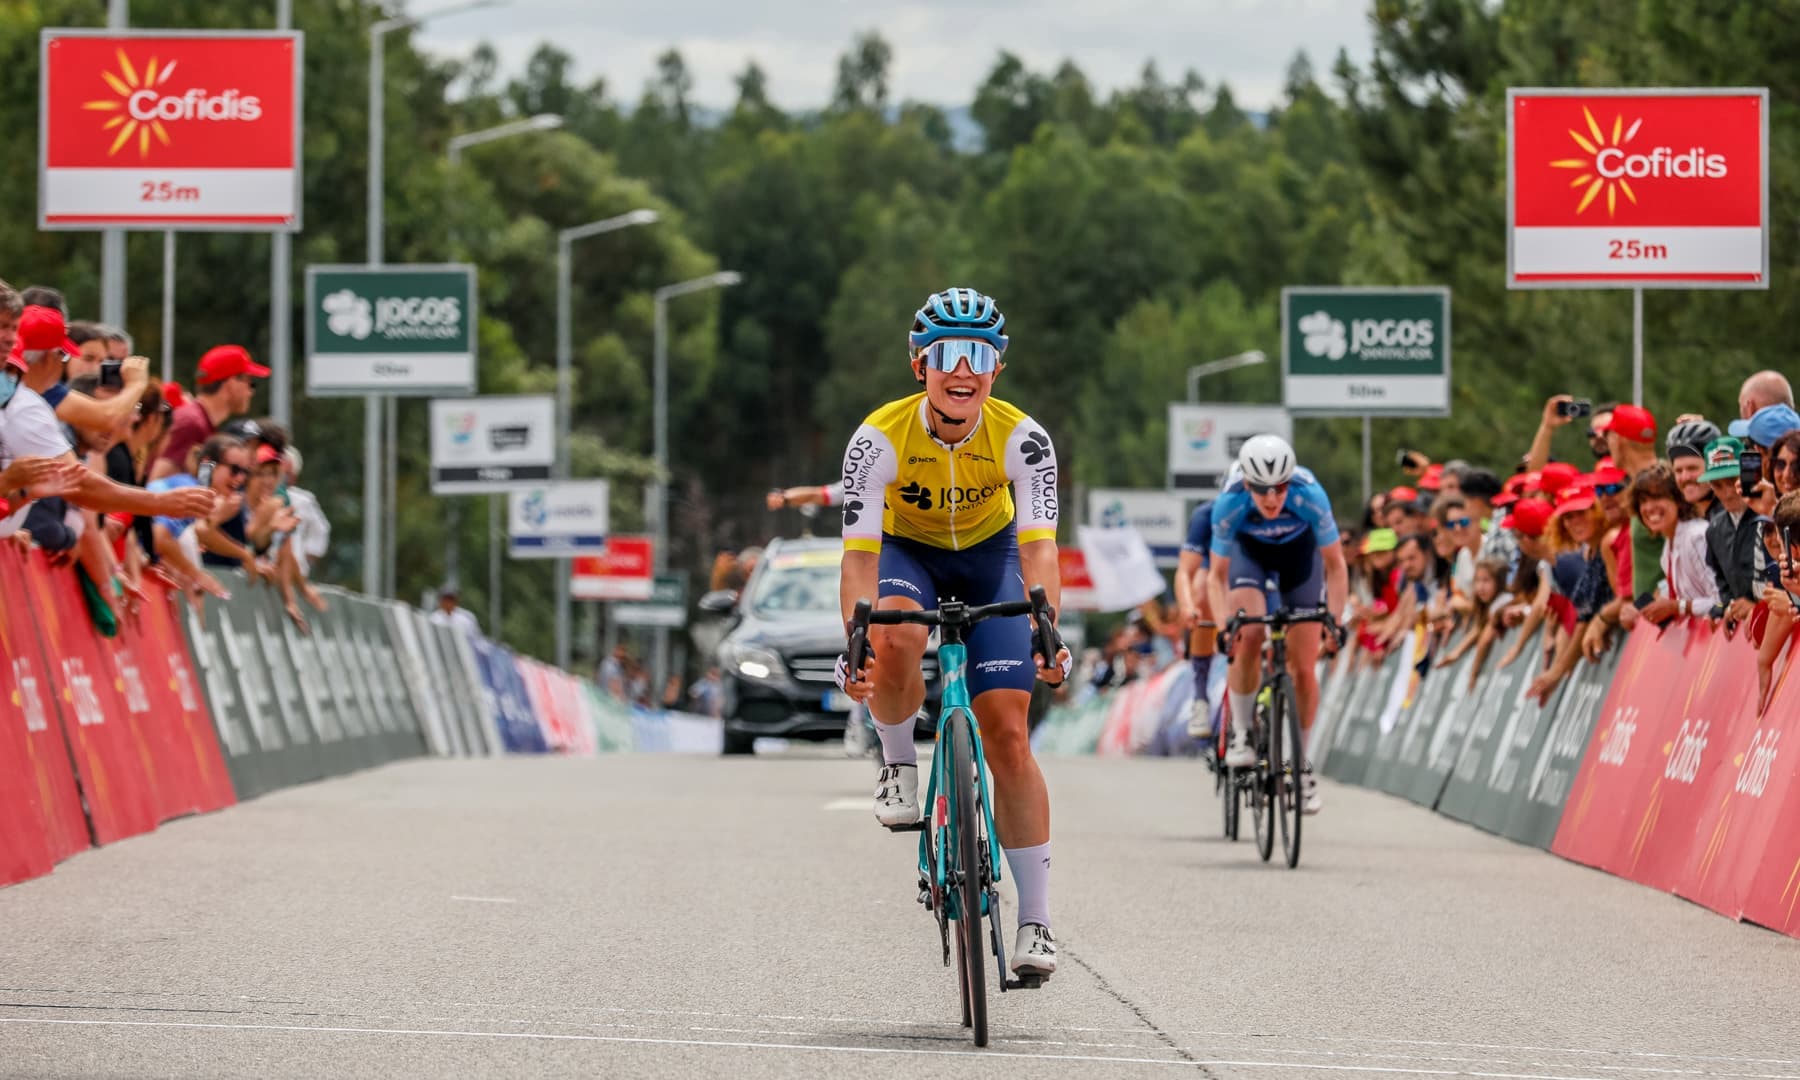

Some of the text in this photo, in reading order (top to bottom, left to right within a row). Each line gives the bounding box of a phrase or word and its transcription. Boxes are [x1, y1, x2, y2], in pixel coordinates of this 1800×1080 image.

[128, 88, 263, 121] Cofidis
[1596, 146, 1728, 178] Cofidis
[140, 180, 201, 202] 25m
[1608, 238, 1668, 260] 25m
[374, 296, 461, 333] JOGOS
[1350, 318, 1435, 353] JOGOS
[844, 436, 873, 497] JOGOS
[856, 447, 884, 491] SANTACASA
[1031, 474, 1042, 520] SANTACASA
[1035, 466, 1057, 521] JOGOS
[984, 665, 1010, 673] TACTIC
